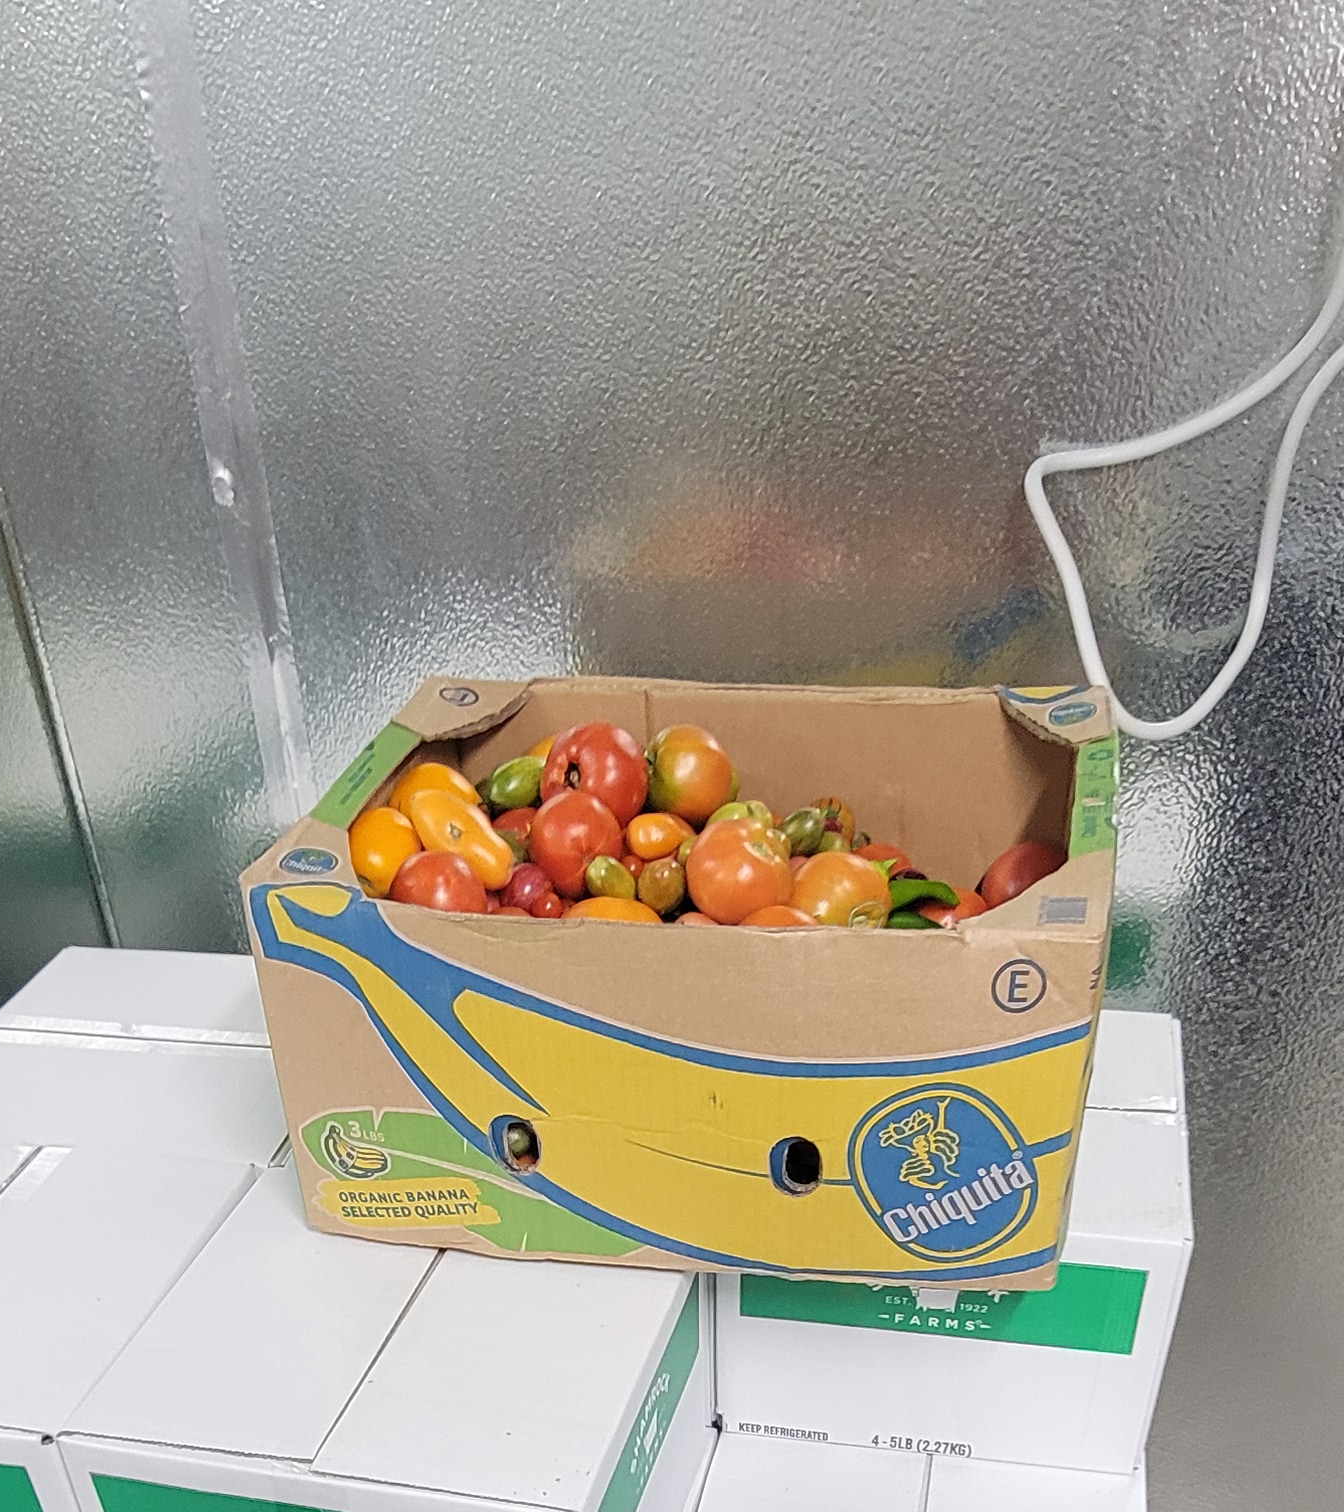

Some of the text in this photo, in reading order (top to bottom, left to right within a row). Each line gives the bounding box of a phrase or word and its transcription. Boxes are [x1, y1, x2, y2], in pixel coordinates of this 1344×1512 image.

[1007, 970, 1030, 1003] E
[348, 1120, 385, 1143] 3 LBS
[338, 1188, 470, 1204] ORGANIC BANANA
[882, 1158, 1035, 1243] Chiquita
[341, 1201, 479, 1219] SELECTED QUALITY
[959, 1302, 989, 1315] 1922
[894, 1313, 976, 1332] FARMS
[738, 1421, 830, 1442] KEEP REFRIGERATED
